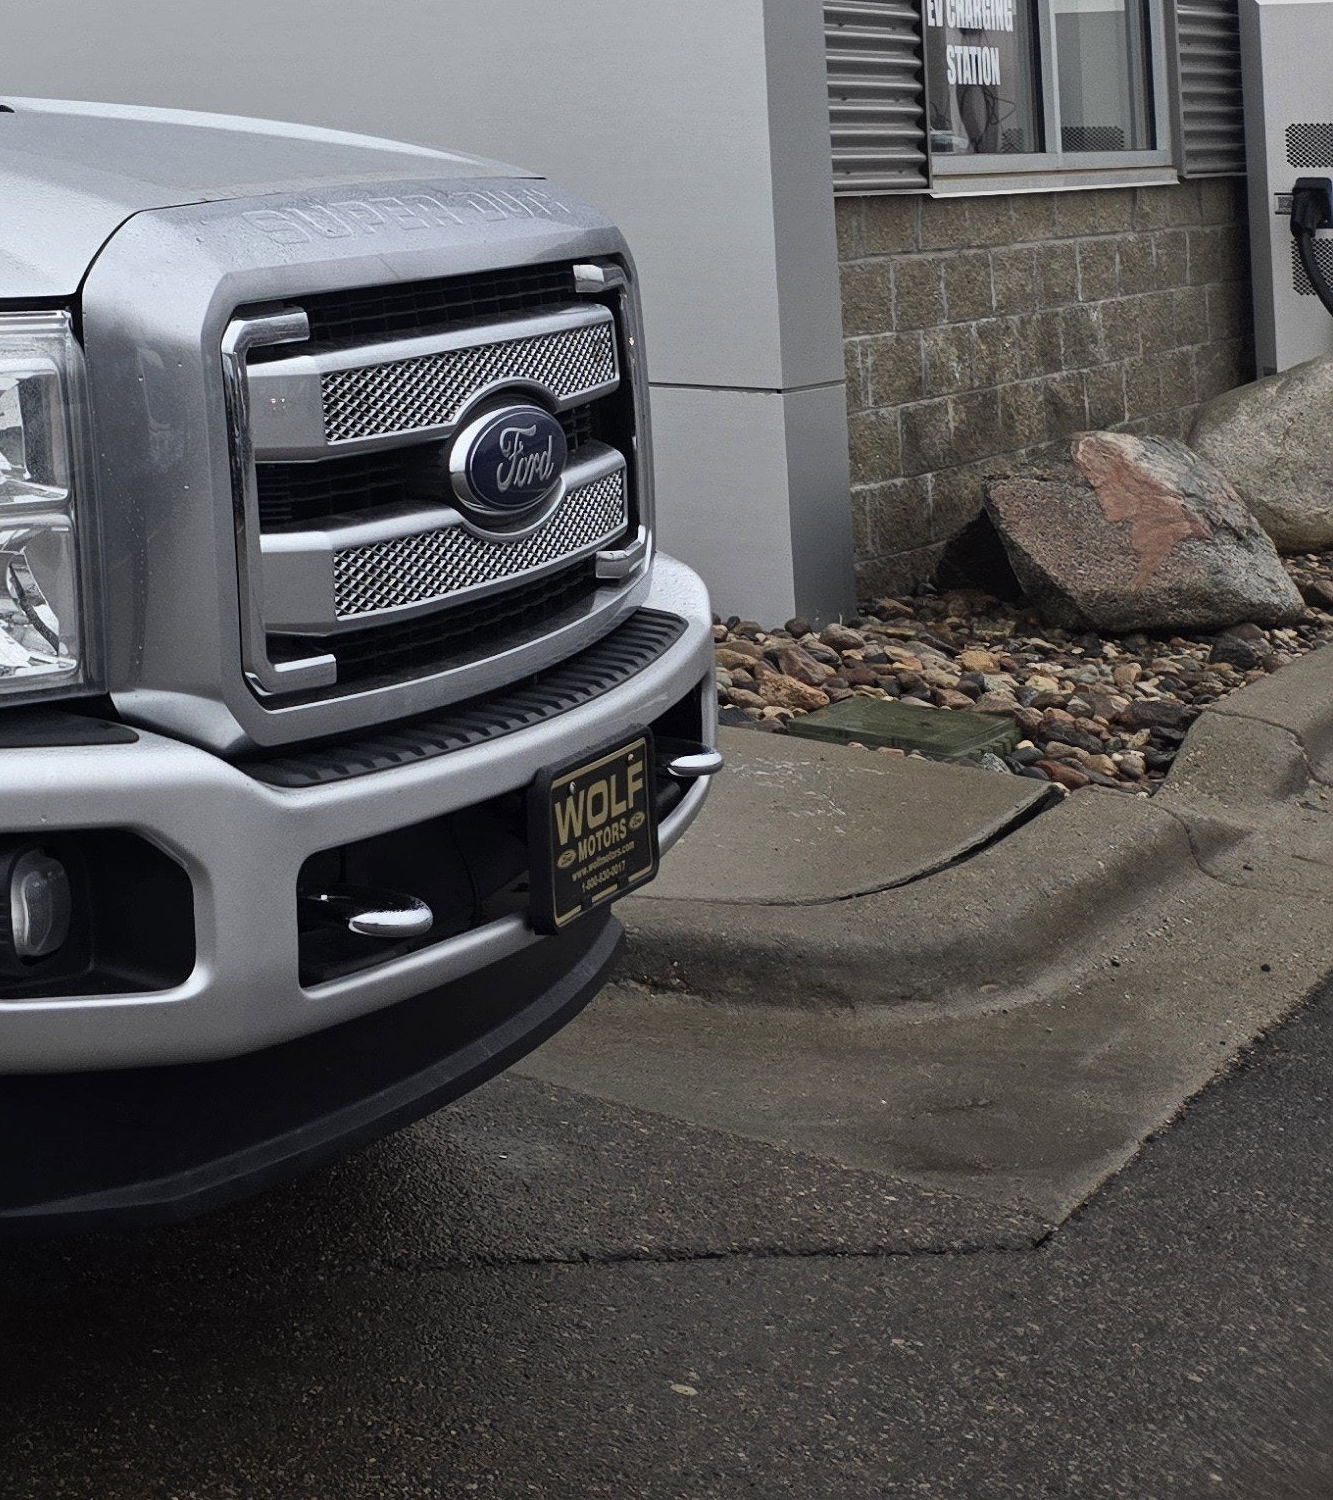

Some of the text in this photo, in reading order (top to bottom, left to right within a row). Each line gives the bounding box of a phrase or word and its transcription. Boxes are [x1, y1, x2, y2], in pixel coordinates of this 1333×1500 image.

[946, 44, 1001, 86] STATION
[241, 195, 463, 246] SUPER
[496, 424, 555, 493] Ford
[554, 759, 644, 846] WOLF
[577, 818, 628, 863] MOTORS
